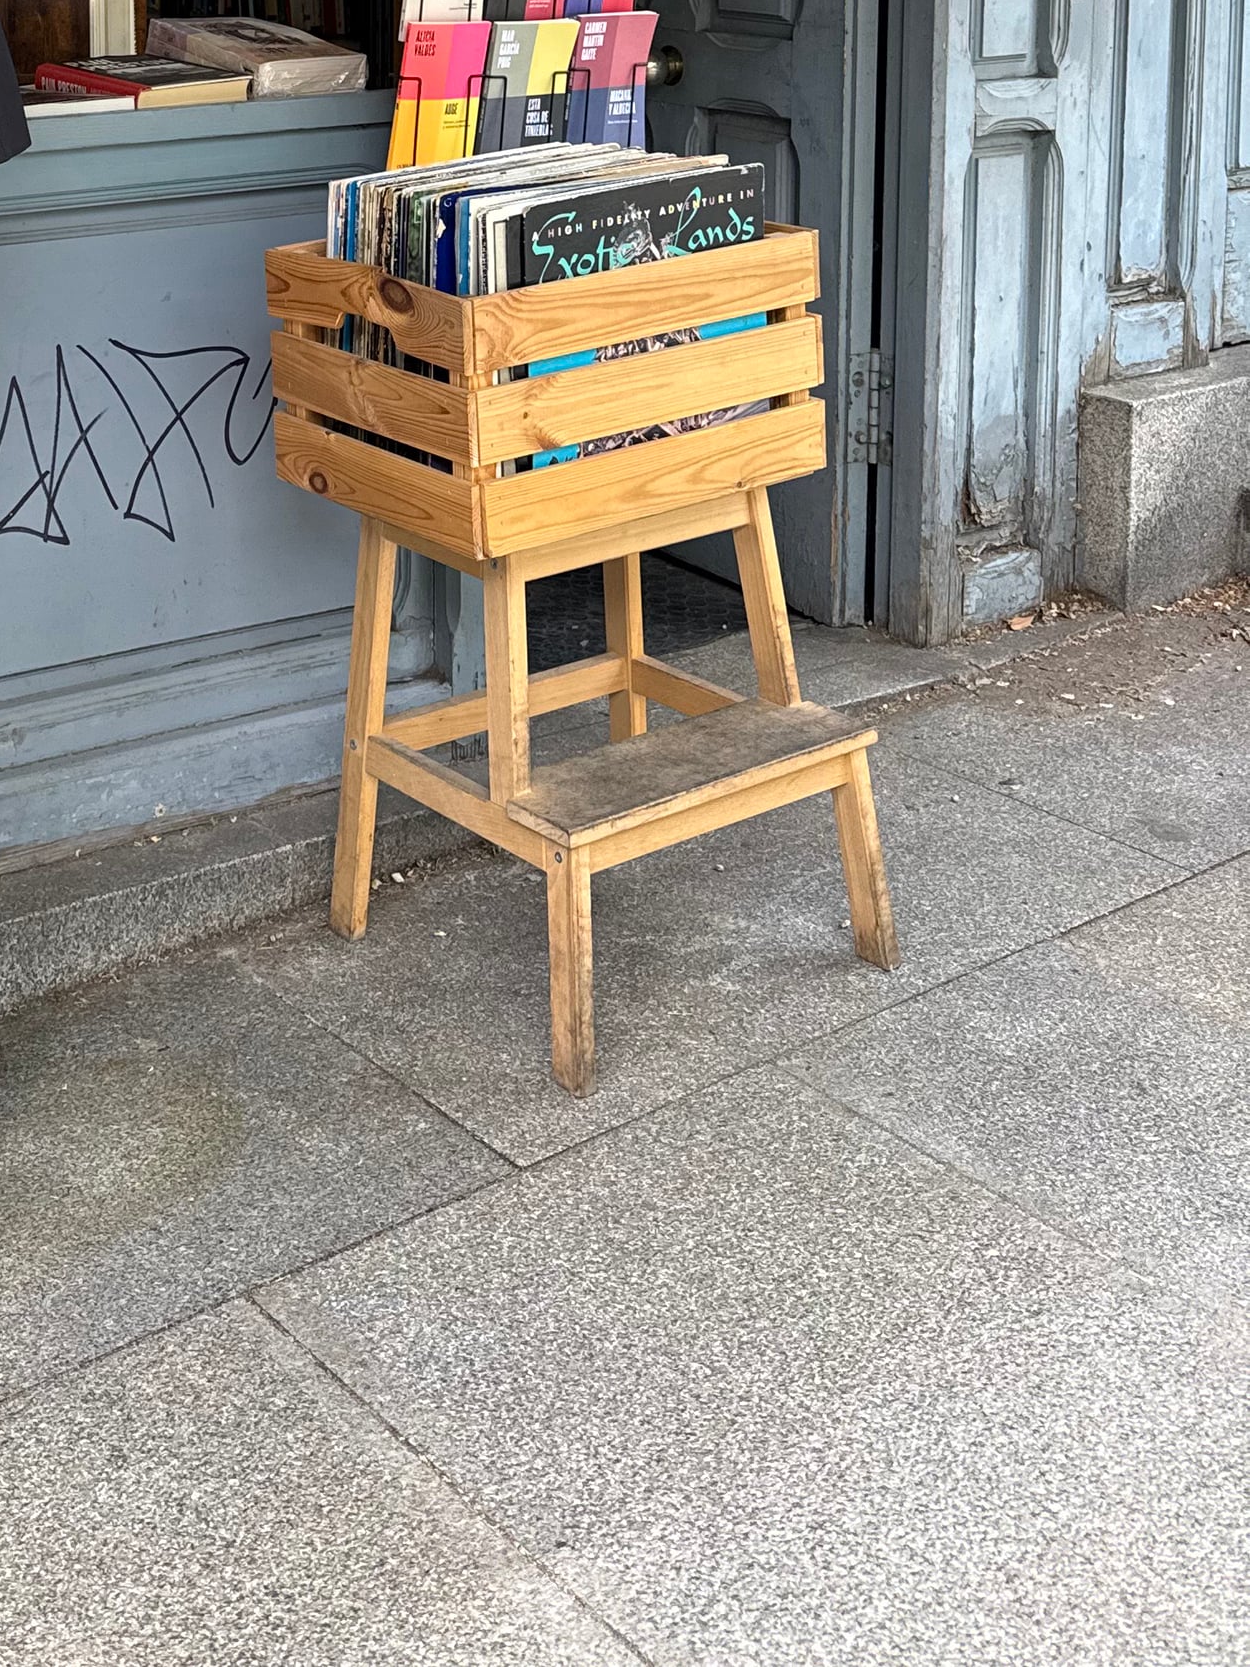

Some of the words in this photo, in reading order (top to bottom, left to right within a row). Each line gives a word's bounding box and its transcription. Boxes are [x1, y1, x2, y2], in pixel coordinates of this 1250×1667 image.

[584, 21, 608, 35] CARMEN
[414, 30, 436, 43] ALICIA
[501, 29, 516, 42] MAR
[499, 41, 520, 56] GARCÍA
[580, 47, 598, 61] GAITE
[497, 56, 512, 69] PUIG
[444, 102, 459, 116] AUGE
[527, 98, 542, 111] ESTA
[525, 111, 541, 125] COSA
[540, 110, 549, 123] DE
[531, 231, 538, 242] A
[547, 223, 583, 238] HIGH
[591, 208, 651, 230] FIDELITY
[658, 193, 733, 216] ADVENTURE
[739, 188, 755, 200] IN
[531, 211, 640, 284] Exotic
[665, 186, 756, 256] Lands
